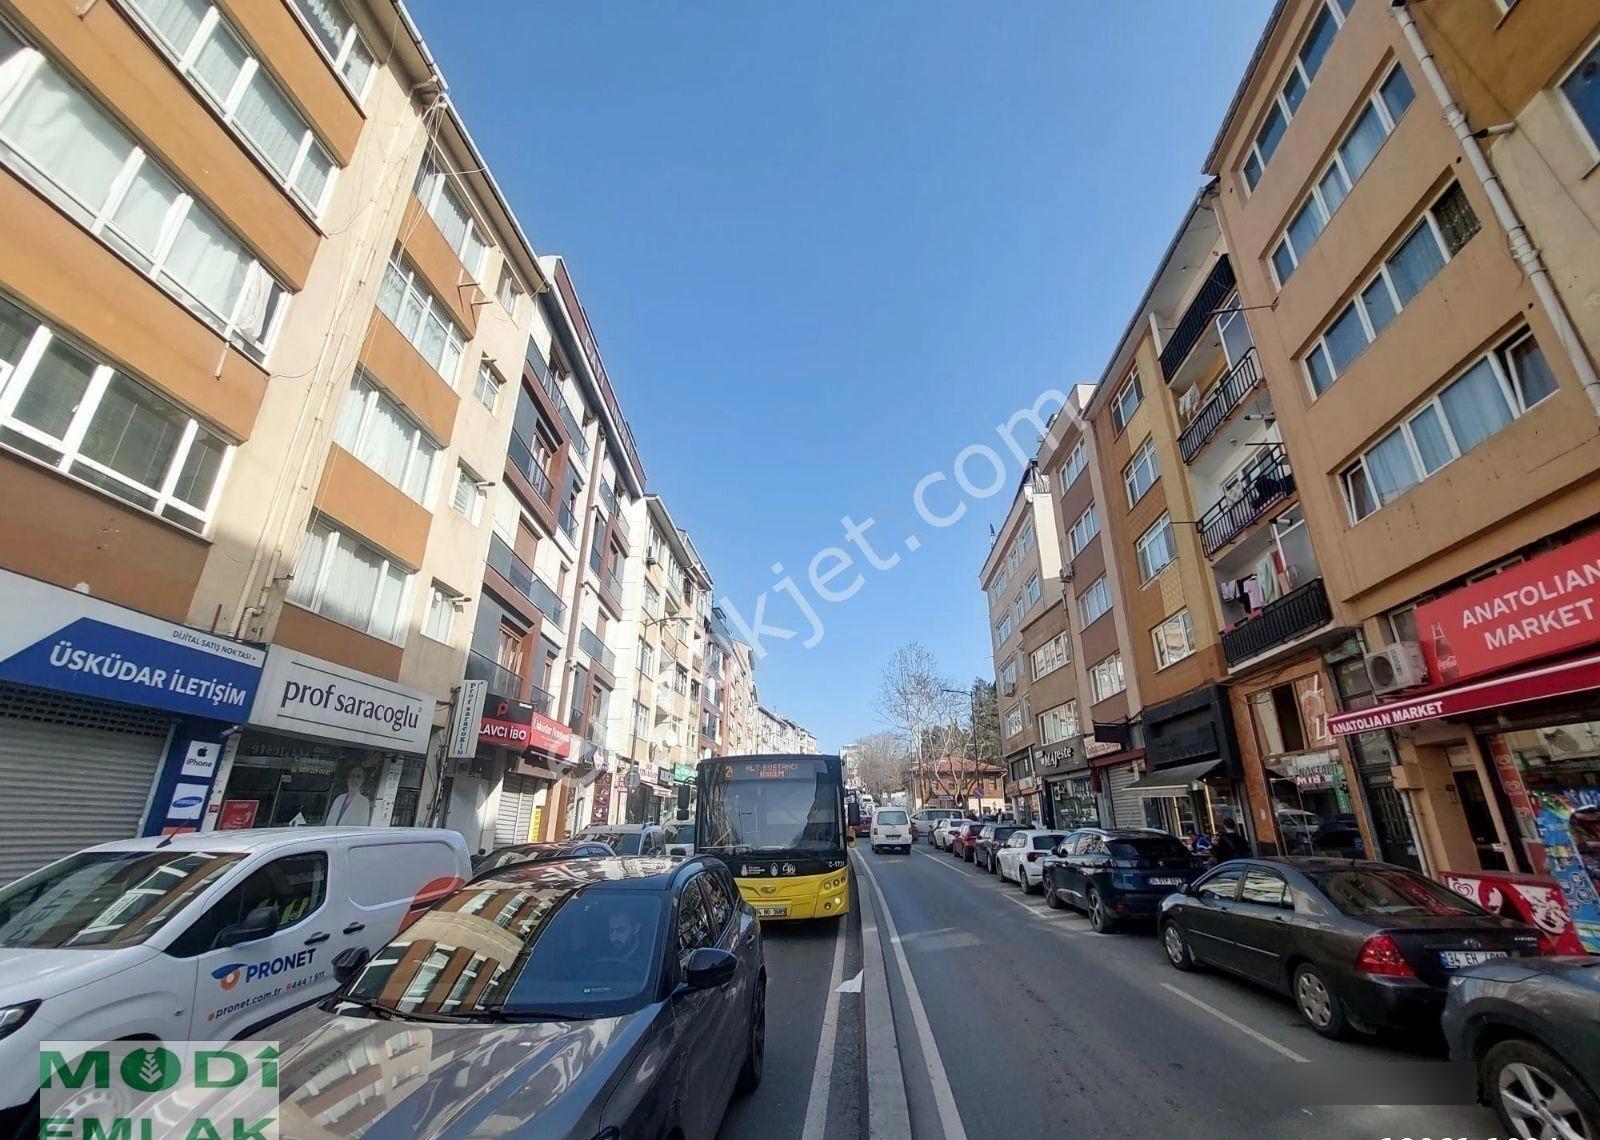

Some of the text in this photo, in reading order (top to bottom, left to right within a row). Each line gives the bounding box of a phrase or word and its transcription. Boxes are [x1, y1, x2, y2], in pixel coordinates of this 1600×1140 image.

[1462, 559, 1600, 629] ANATOLIAN
[1484, 598, 1594, 650] MARKET
[173, 630, 251, 660] DİJİTAL SATIŞ NOKTASI
[50, 640, 247, 706] ÜSKÜDAR İLETİŞİM
[281, 680, 419, 731] prof saracoglu
[1332, 701, 1443, 735] ANATOLIAN MARKET
[510, 726, 527, 741] İBO
[186, 758, 213, 769] iPhone
[245, 949, 315, 982] PRONET
[1448, 953, 1462, 966] 34
[216, 987, 281, 1018] pronet.com.tr
[292, 978, 308, 989] 444
